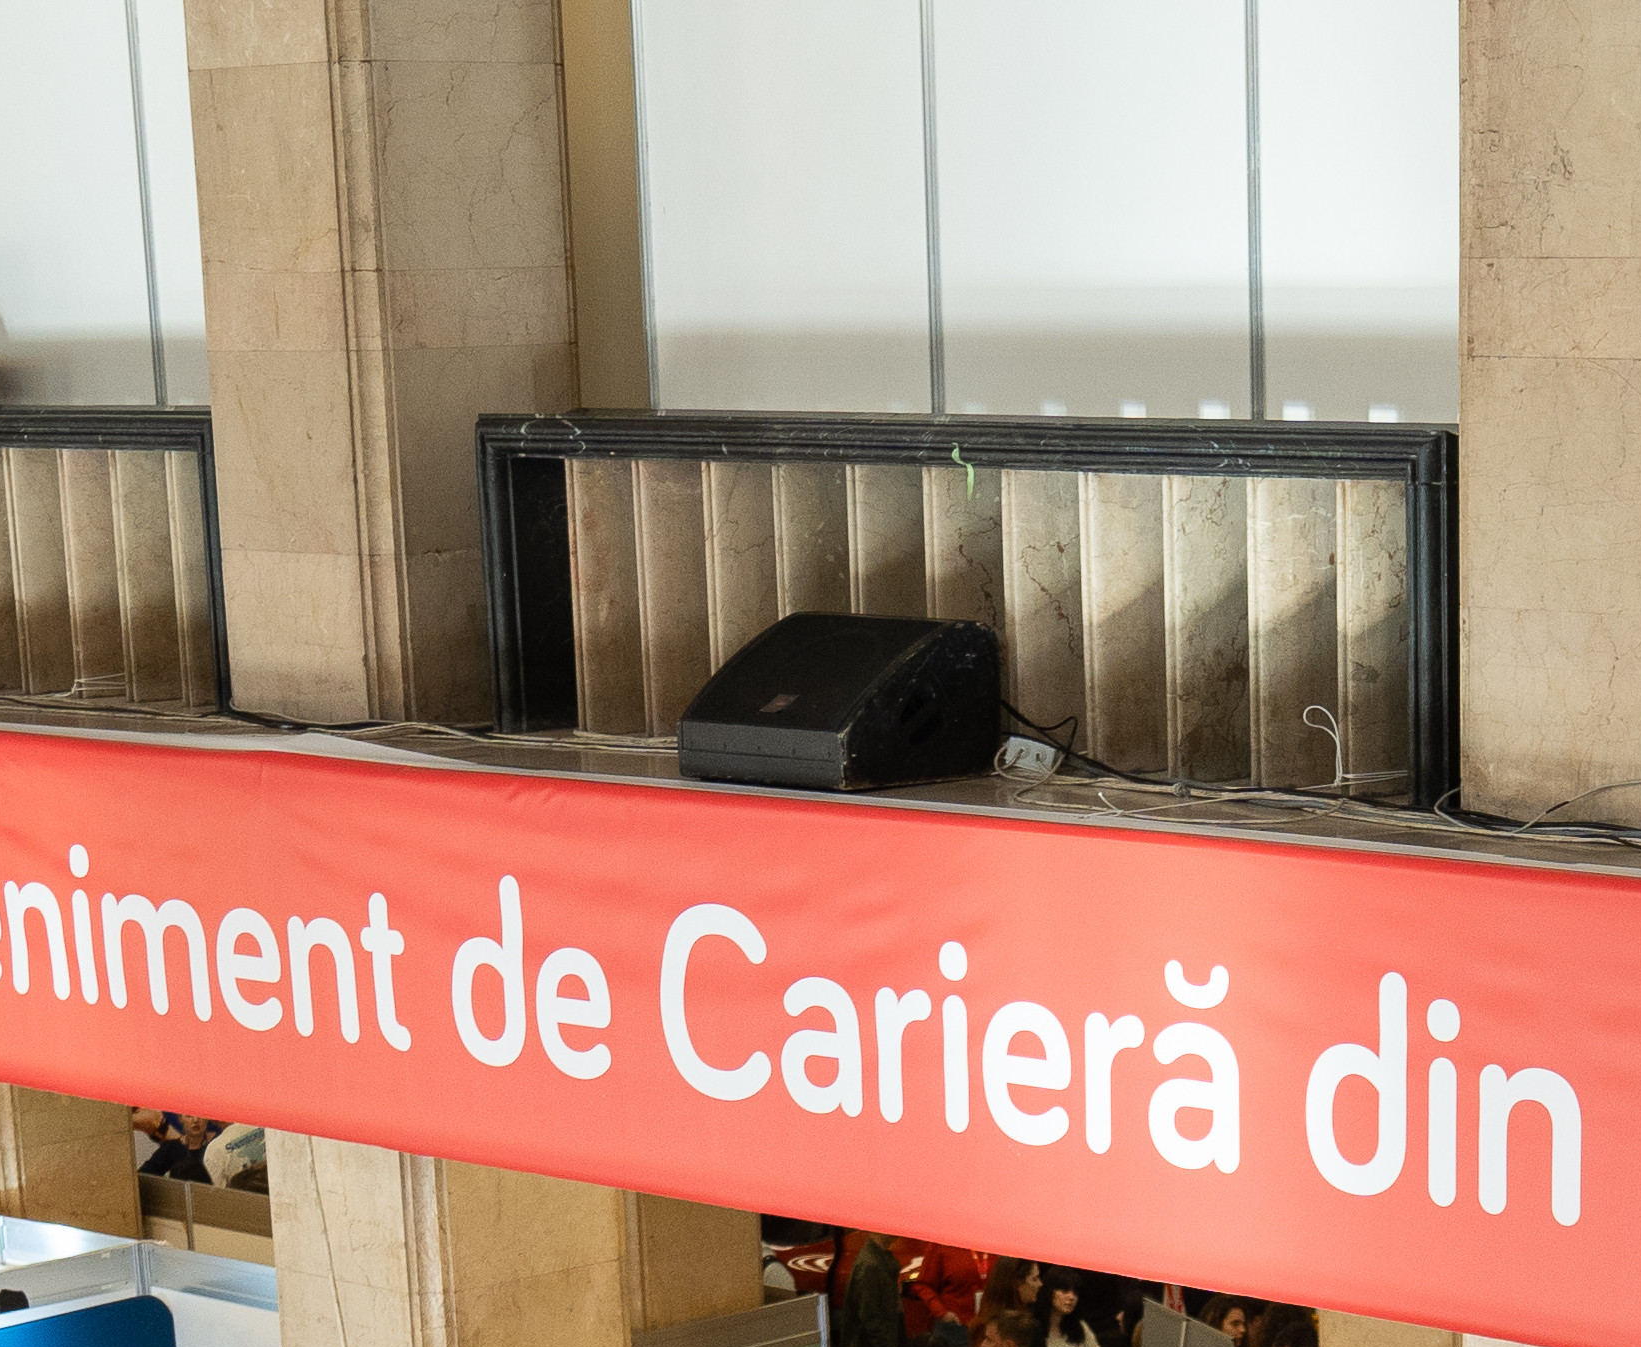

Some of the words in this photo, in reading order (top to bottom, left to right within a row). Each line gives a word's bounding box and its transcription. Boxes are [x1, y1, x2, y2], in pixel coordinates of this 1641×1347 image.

[452, 874, 611, 1080] de
[660, 903, 1240, 1174] Carieră
[1306, 971, 1581, 1227] din
